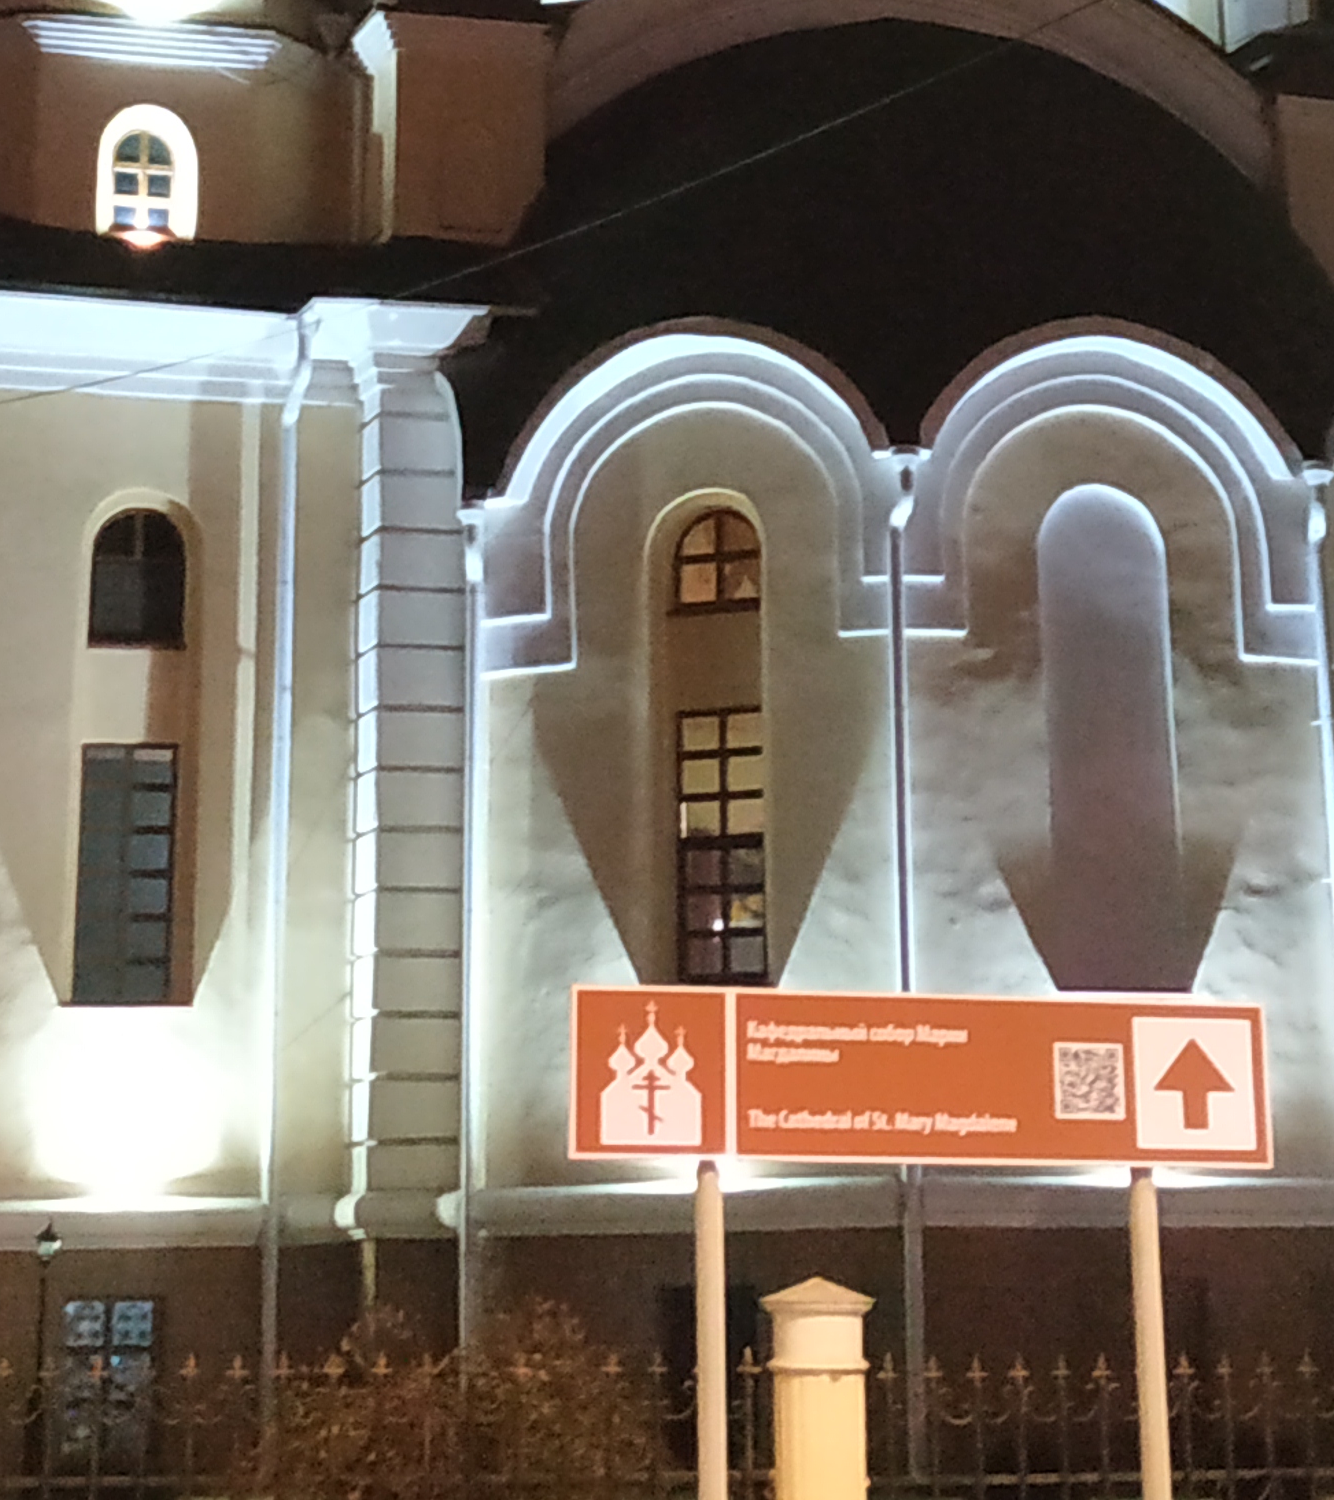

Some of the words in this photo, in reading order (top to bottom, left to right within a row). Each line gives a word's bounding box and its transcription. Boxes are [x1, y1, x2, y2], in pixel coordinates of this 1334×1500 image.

[748, 1109, 776, 1128] The
[778, 1110, 852, 1129] Cathedral
[853, 1111, 871, 1129] of
[872, 1112, 893, 1130] St.
[894, 1112, 933, 1134] Mary
